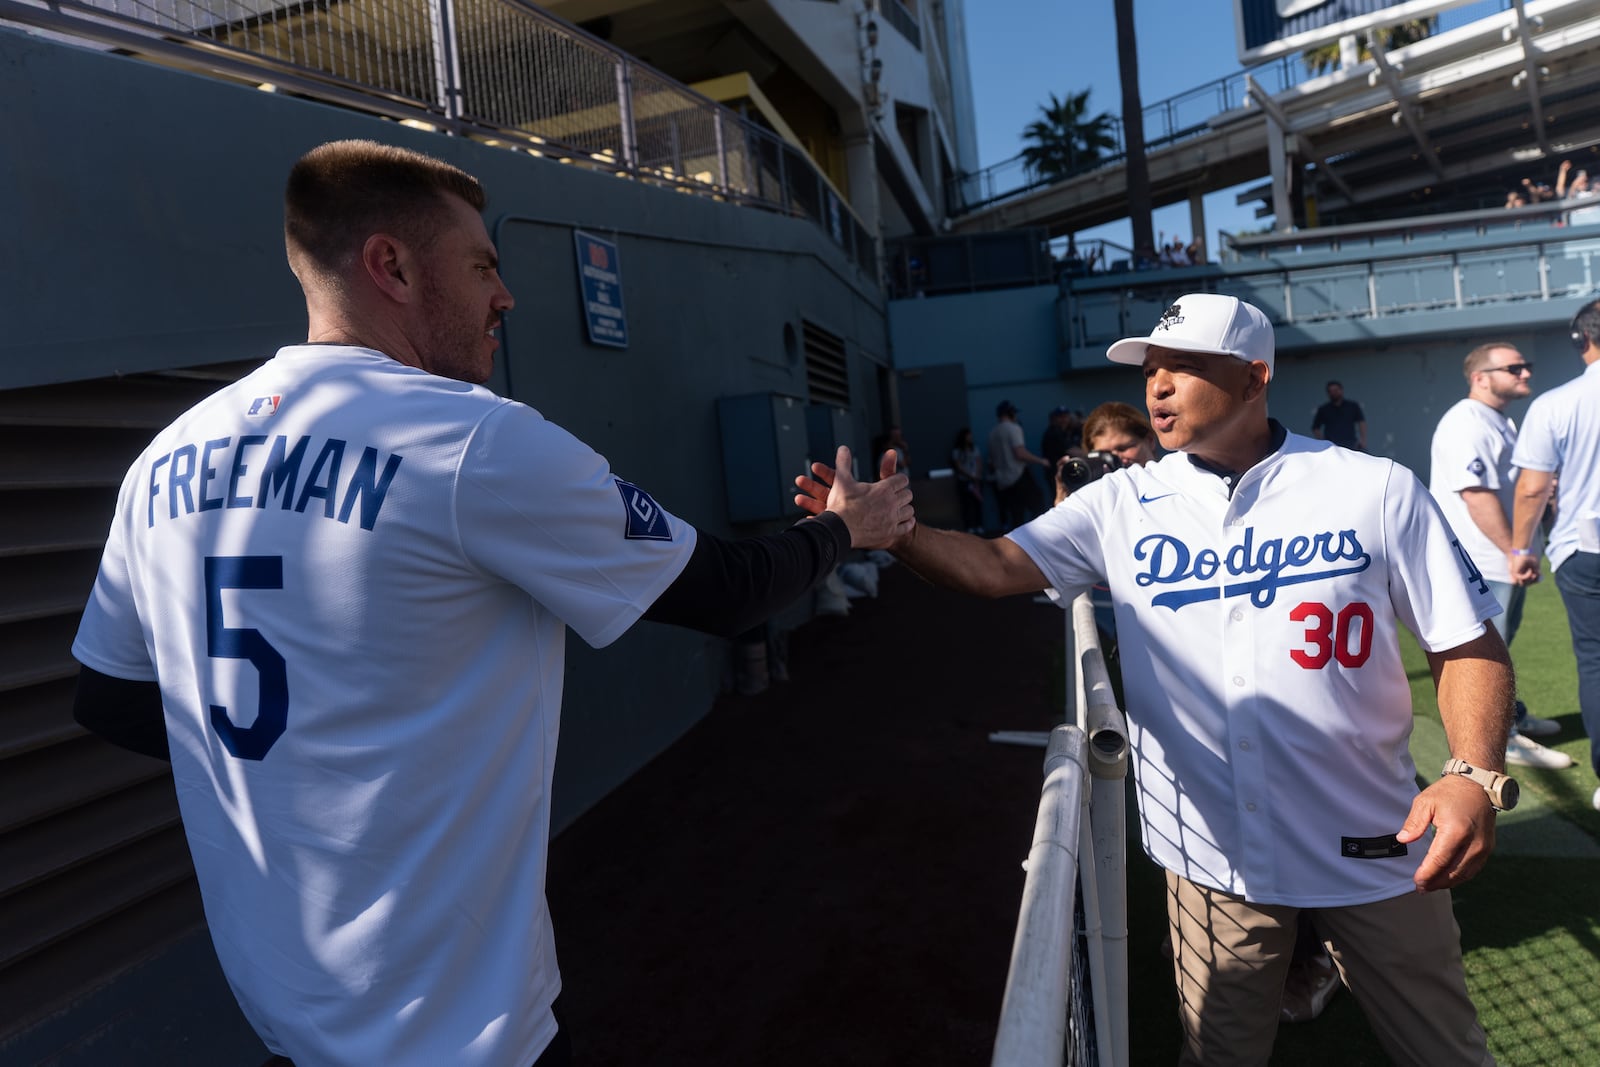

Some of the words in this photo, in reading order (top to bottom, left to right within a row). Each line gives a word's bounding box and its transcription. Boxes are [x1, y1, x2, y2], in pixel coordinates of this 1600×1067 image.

[148, 434, 402, 531] FREEMAN
[1135, 527, 1371, 608] Dodgers
[205, 556, 289, 761] 5
[1289, 602, 1374, 670] 30
